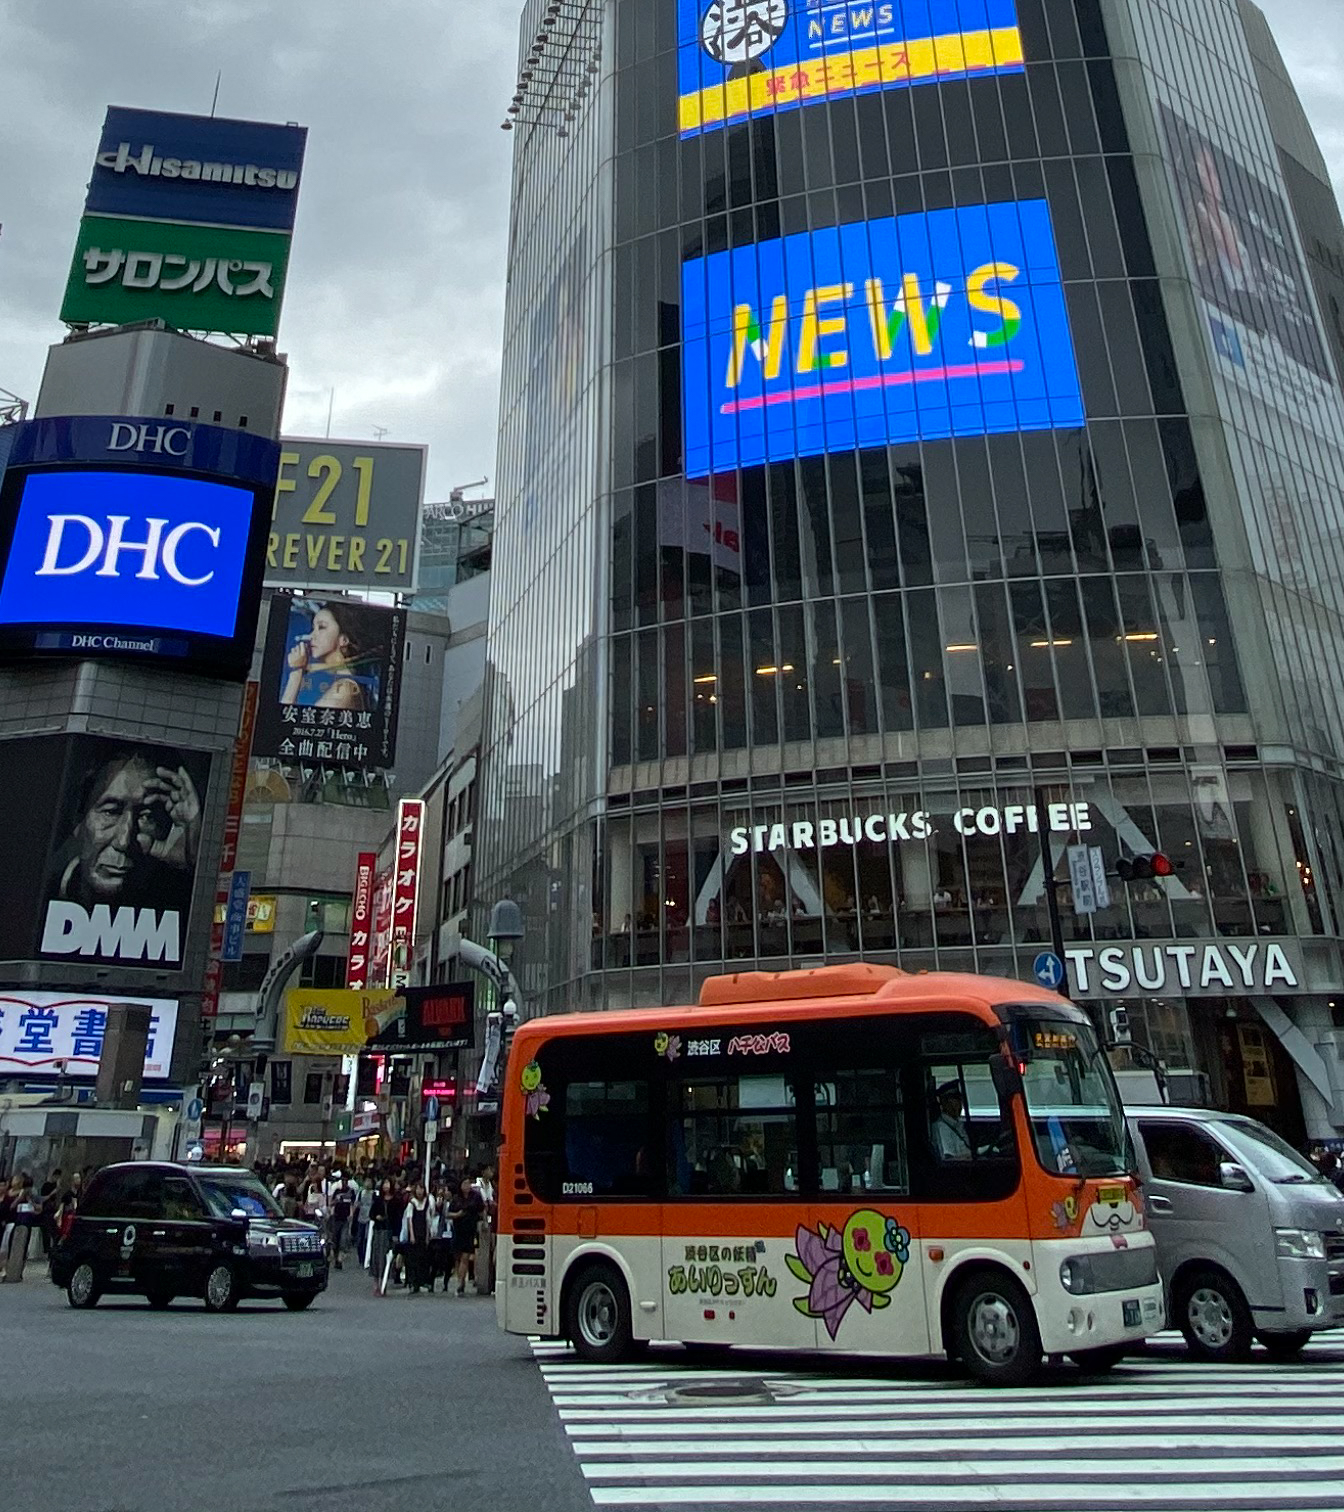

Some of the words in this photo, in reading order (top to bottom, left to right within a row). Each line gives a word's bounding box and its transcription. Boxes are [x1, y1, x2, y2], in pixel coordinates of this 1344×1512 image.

[808, 4, 894, 40] NEWS
[765, 50, 912, 97] 緊急ニュース
[97, 141, 300, 192] Hisamitsu
[82, 245, 275, 300] サロンパス
[725, 261, 1022, 388] NEWS
[104, 420, 193, 458] DHC
[270, 452, 374, 529] F21
[34, 513, 221, 587] DHC
[266, 532, 367, 573] REVER
[374, 538, 408, 575] 21
[71, 633, 102, 649] DHC
[102, 635, 155, 652] Channel
[281, 705, 372, 729] 安室奈美恵
[278, 737, 368, 762] 全曲配信中
[729, 809, 933, 856] STARBUCKS
[395, 814, 419, 915] カラオケ
[356, 889, 370, 921] ECHO
[40, 899, 180, 962] DMM
[349, 930, 368, 991] カラオ
[1066, 942, 1299, 992] TSUTAYA
[687, 1039, 721, 1056] 渋谷区
[727, 1031, 791, 1056] ハチ公バス
[668, 1263, 777, 1298] あいりっすん
